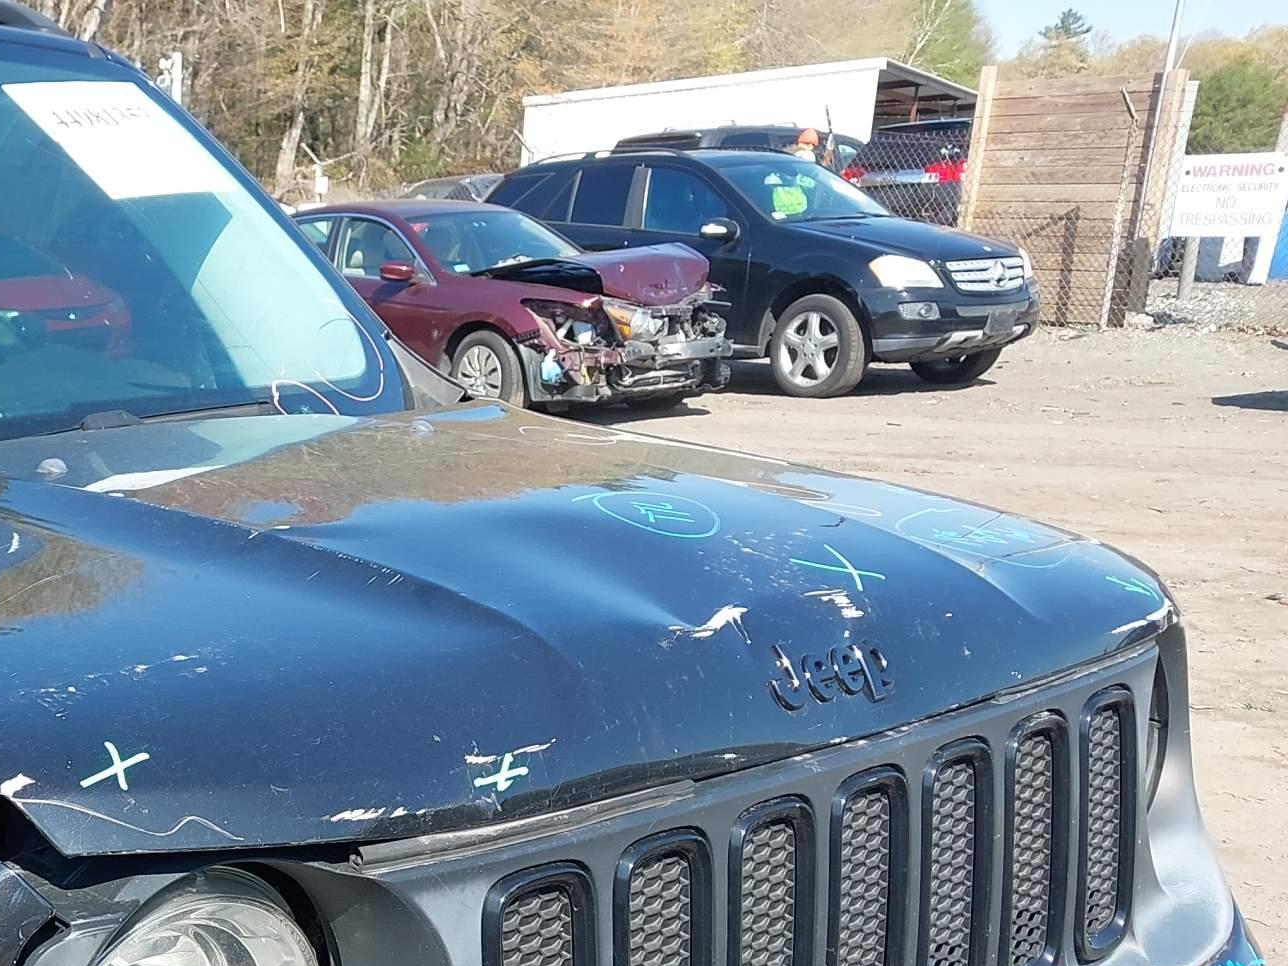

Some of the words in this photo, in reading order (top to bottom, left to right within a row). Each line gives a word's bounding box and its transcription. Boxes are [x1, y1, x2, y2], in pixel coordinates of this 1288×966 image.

[1192, 163, 1276, 177] WARNING
[1181, 184, 1233, 193] ELECTRONIC
[1237, 182, 1279, 192] SECURITY
[1215, 196, 1237, 209] NO
[1179, 212, 1273, 226] TRESPASSING
[767, 639, 896, 713] Jeep
